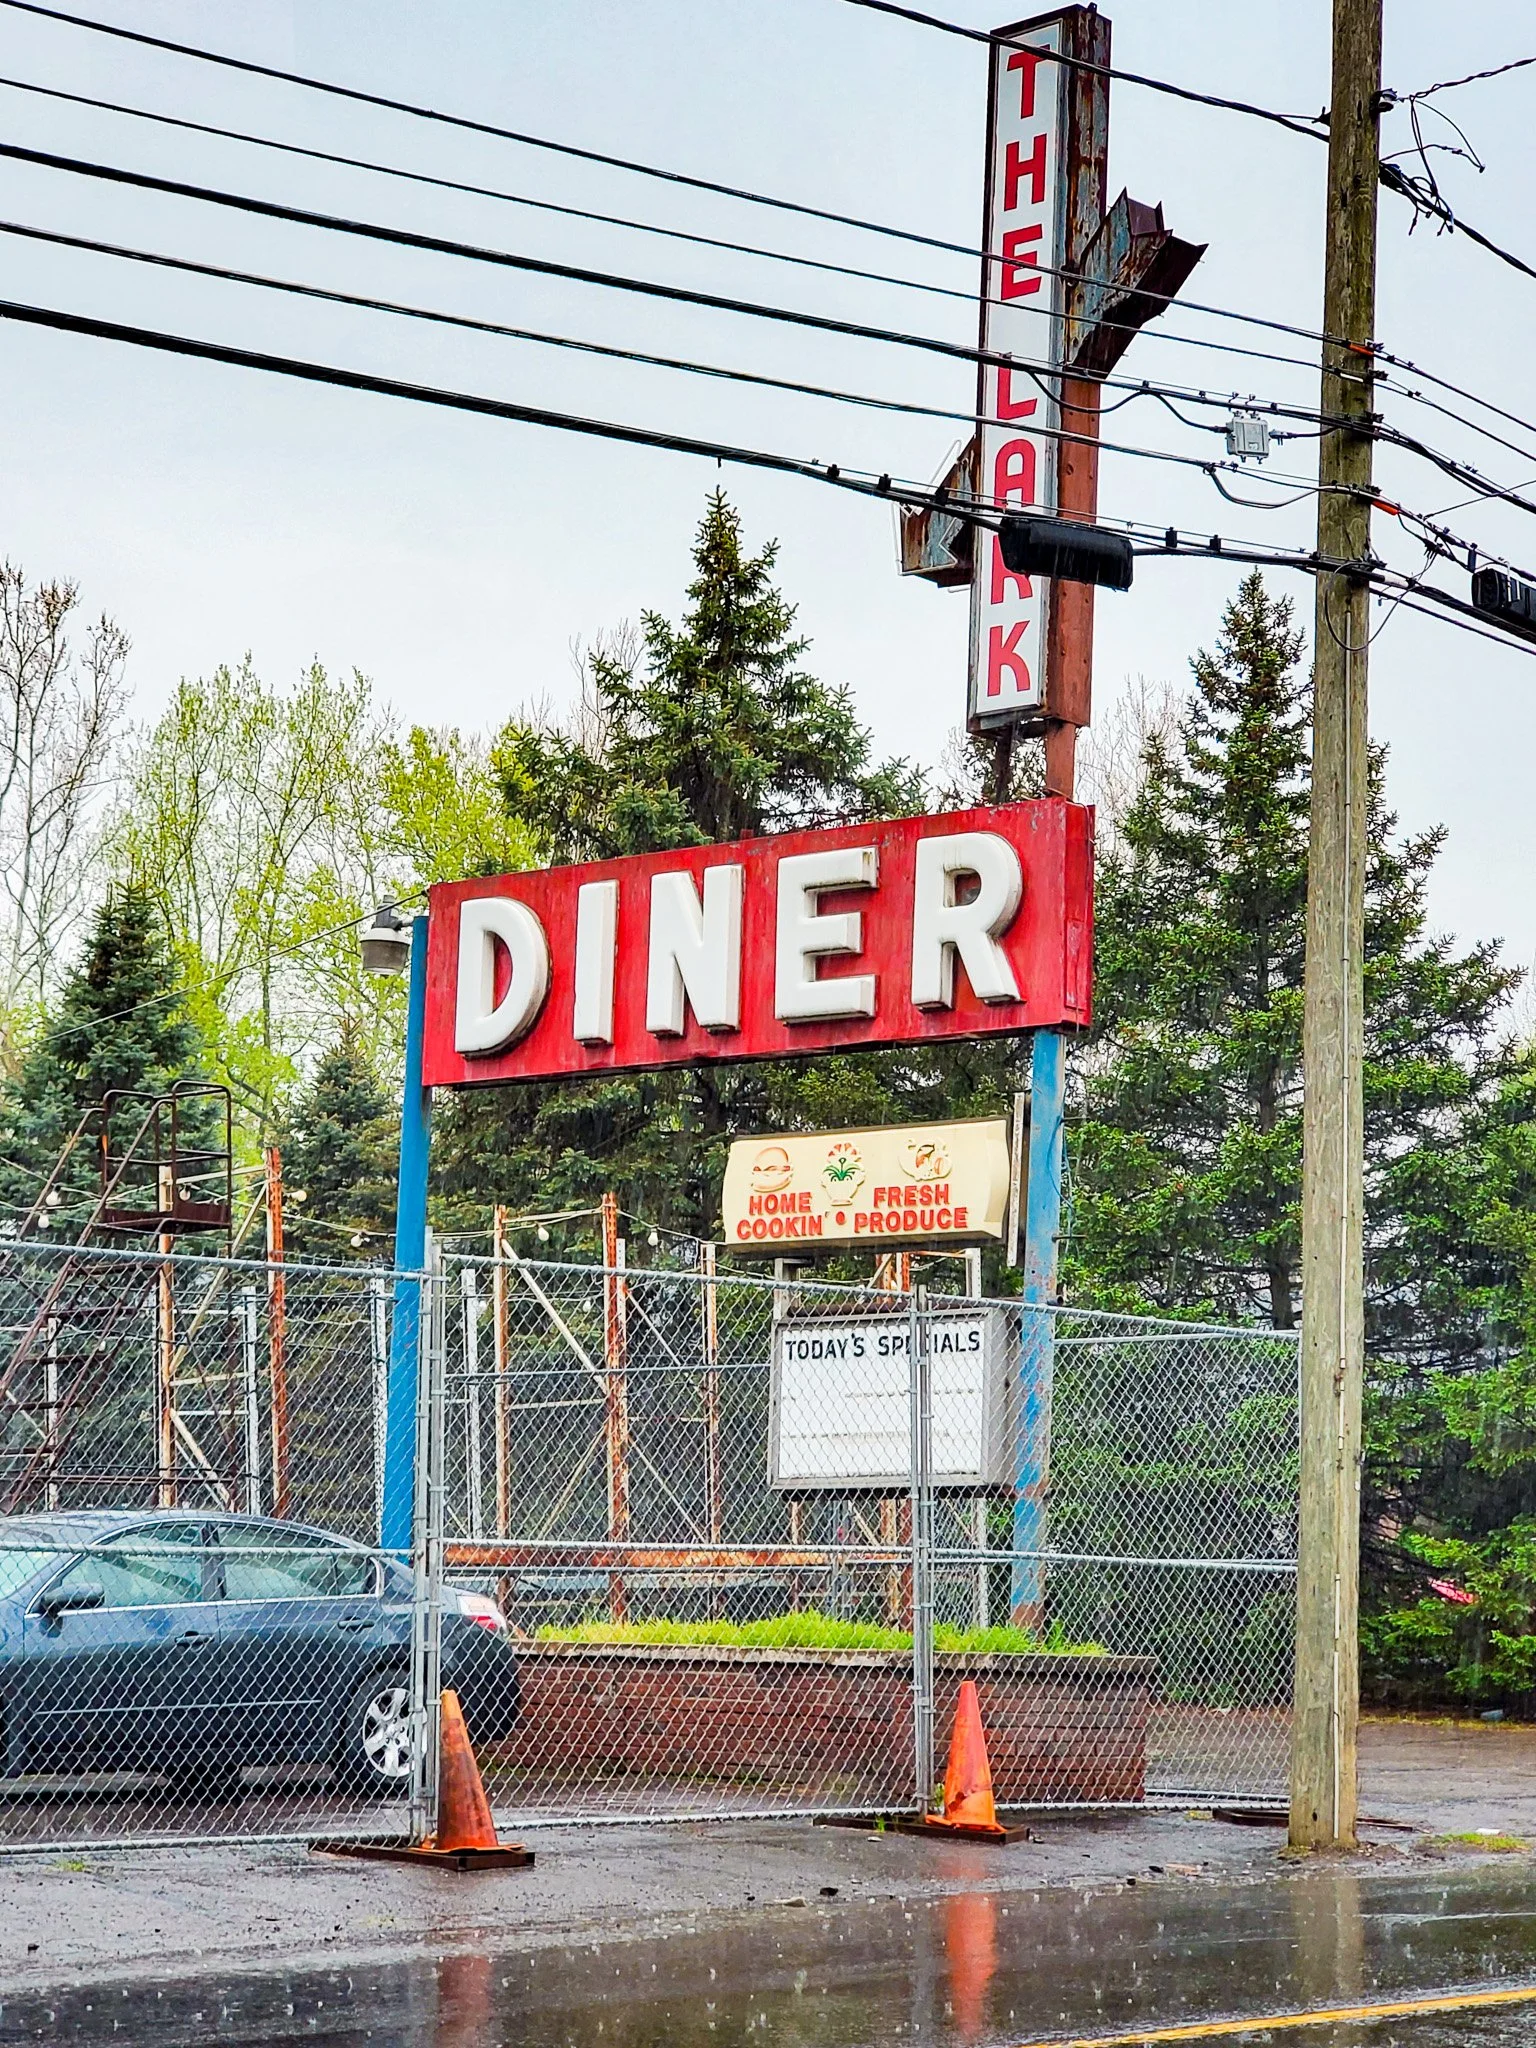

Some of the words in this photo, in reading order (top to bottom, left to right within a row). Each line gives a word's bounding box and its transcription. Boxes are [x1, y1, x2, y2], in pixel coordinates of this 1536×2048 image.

[1000, 44, 1051, 301] THE
[454, 831, 1026, 1060] DINER
[749, 1191, 812, 1216] HOME
[873, 1183, 950, 1209] FRESH
[854, 1206, 968, 1234] PRODUCE
[785, 1333, 865, 1361] TODAY'S
[878, 1330, 980, 1357] SPIALS
